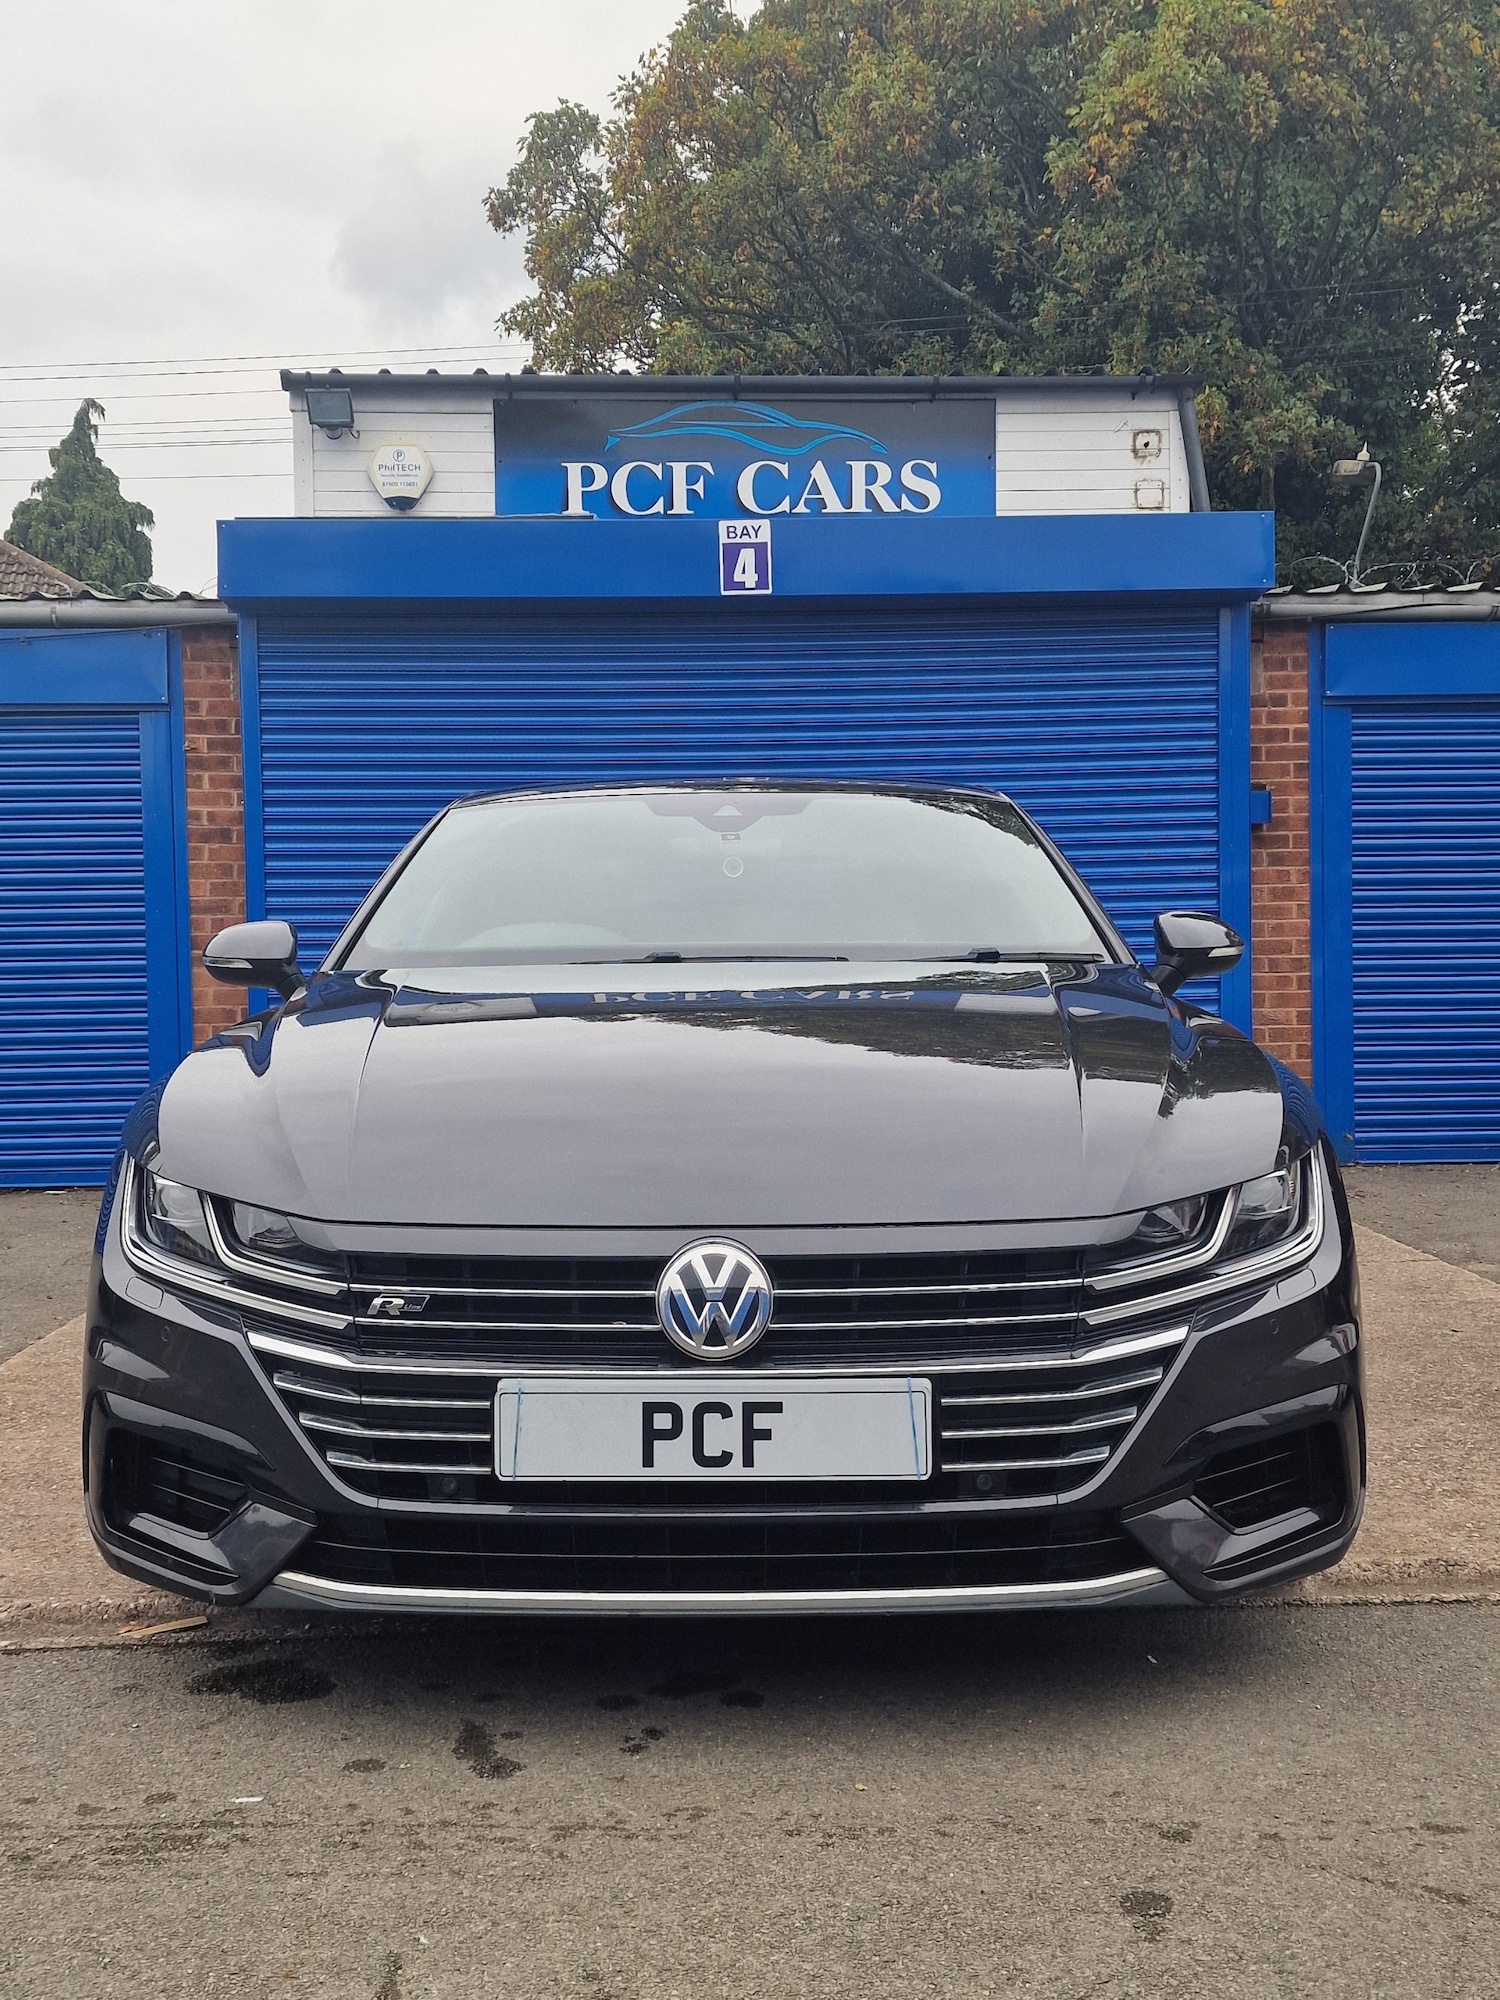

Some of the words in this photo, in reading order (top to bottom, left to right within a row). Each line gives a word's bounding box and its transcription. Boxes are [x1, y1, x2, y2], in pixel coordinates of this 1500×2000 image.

[561, 461, 715, 515] PCF
[737, 460, 942, 515] CARS
[726, 525, 762, 539] BAY
[733, 548, 759, 589] 4
[367, 1297, 405, 1316] R
[663, 1246, 767, 1355] VW
[641, 1401, 783, 1468] PCF
